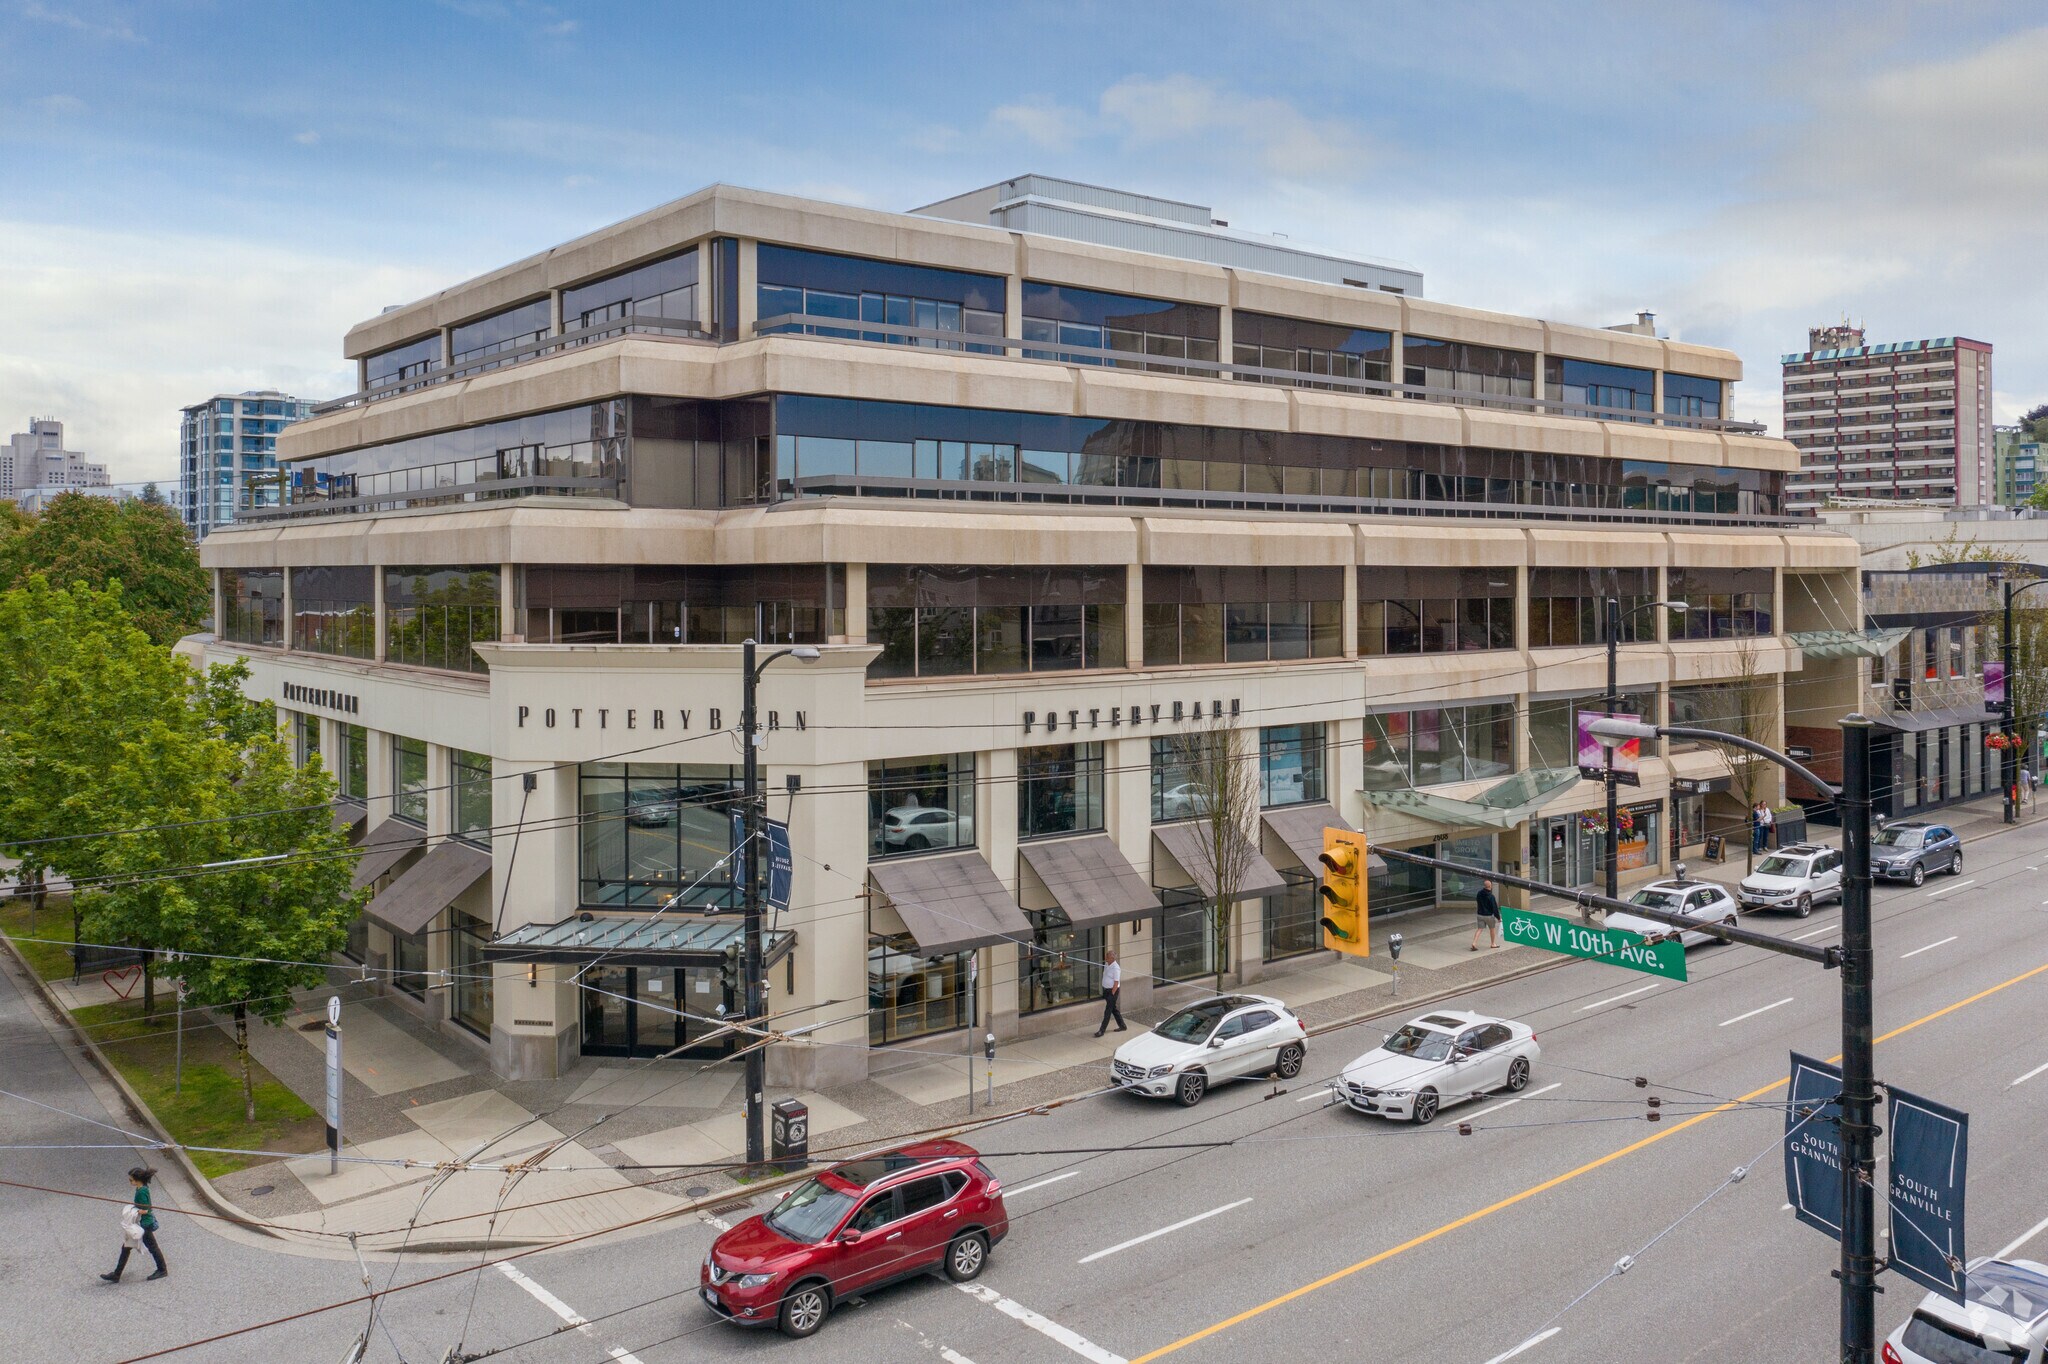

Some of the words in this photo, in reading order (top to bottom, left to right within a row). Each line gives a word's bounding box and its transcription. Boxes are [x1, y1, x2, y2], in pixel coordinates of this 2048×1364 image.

[1544, 922, 1562, 946] W
[1568, 928, 1614, 958] 10th
[1620, 938, 1665, 969] Ave.
[1790, 1141, 1842, 1171] GRANVILL
[1803, 1132, 1838, 1156] SOUTH
[1889, 1182, 1952, 1221] GRANVILLE
[1898, 1174, 1938, 1201] SOUTH
